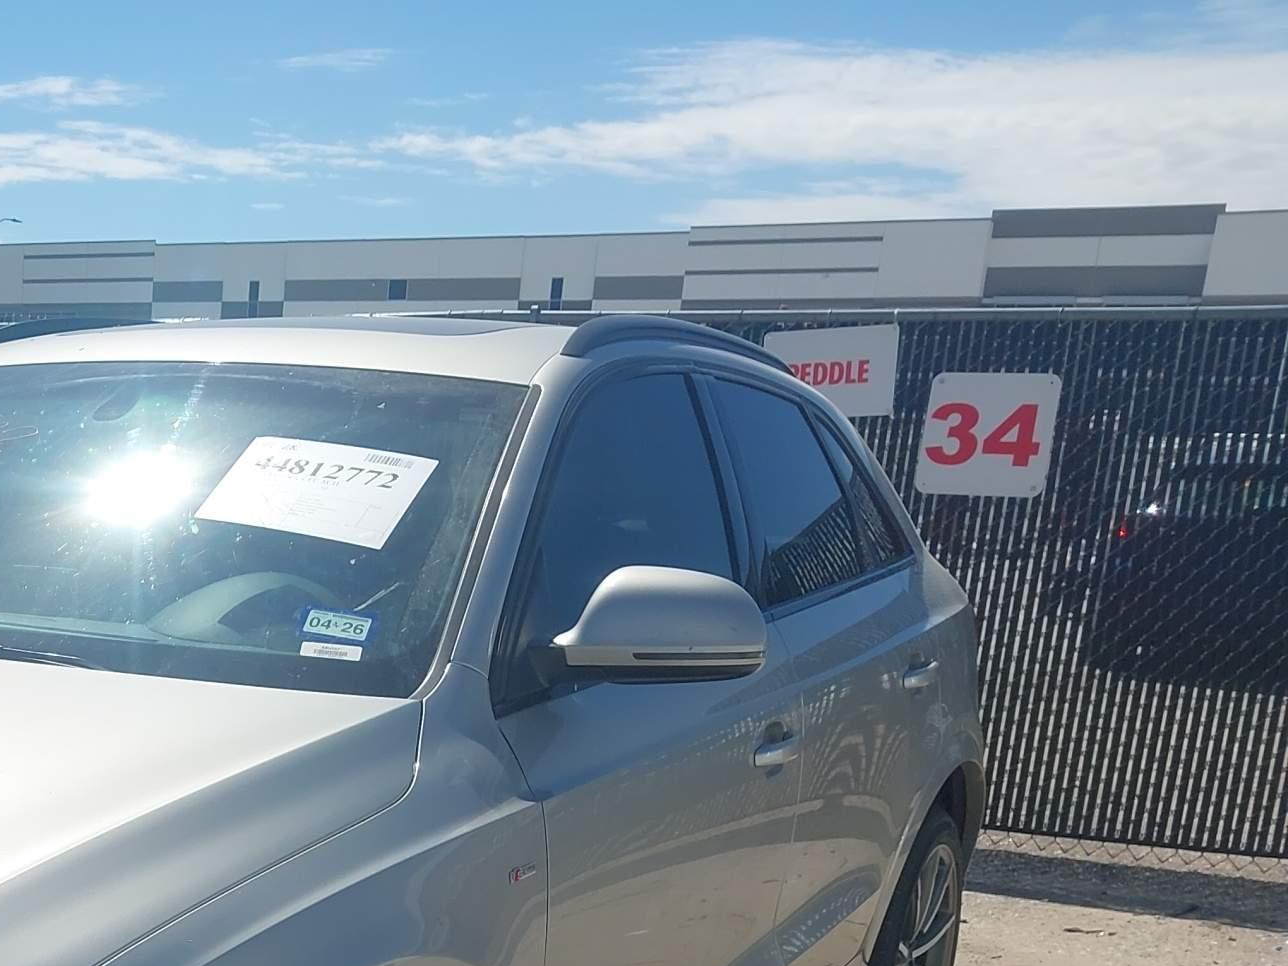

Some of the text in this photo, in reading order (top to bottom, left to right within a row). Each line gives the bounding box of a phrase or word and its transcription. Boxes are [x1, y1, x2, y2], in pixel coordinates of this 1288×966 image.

[925, 402, 1041, 467] 34
[255, 456, 400, 489] 44812772
[309, 616, 333, 630] 04
[340, 621, 366, 636] 26
